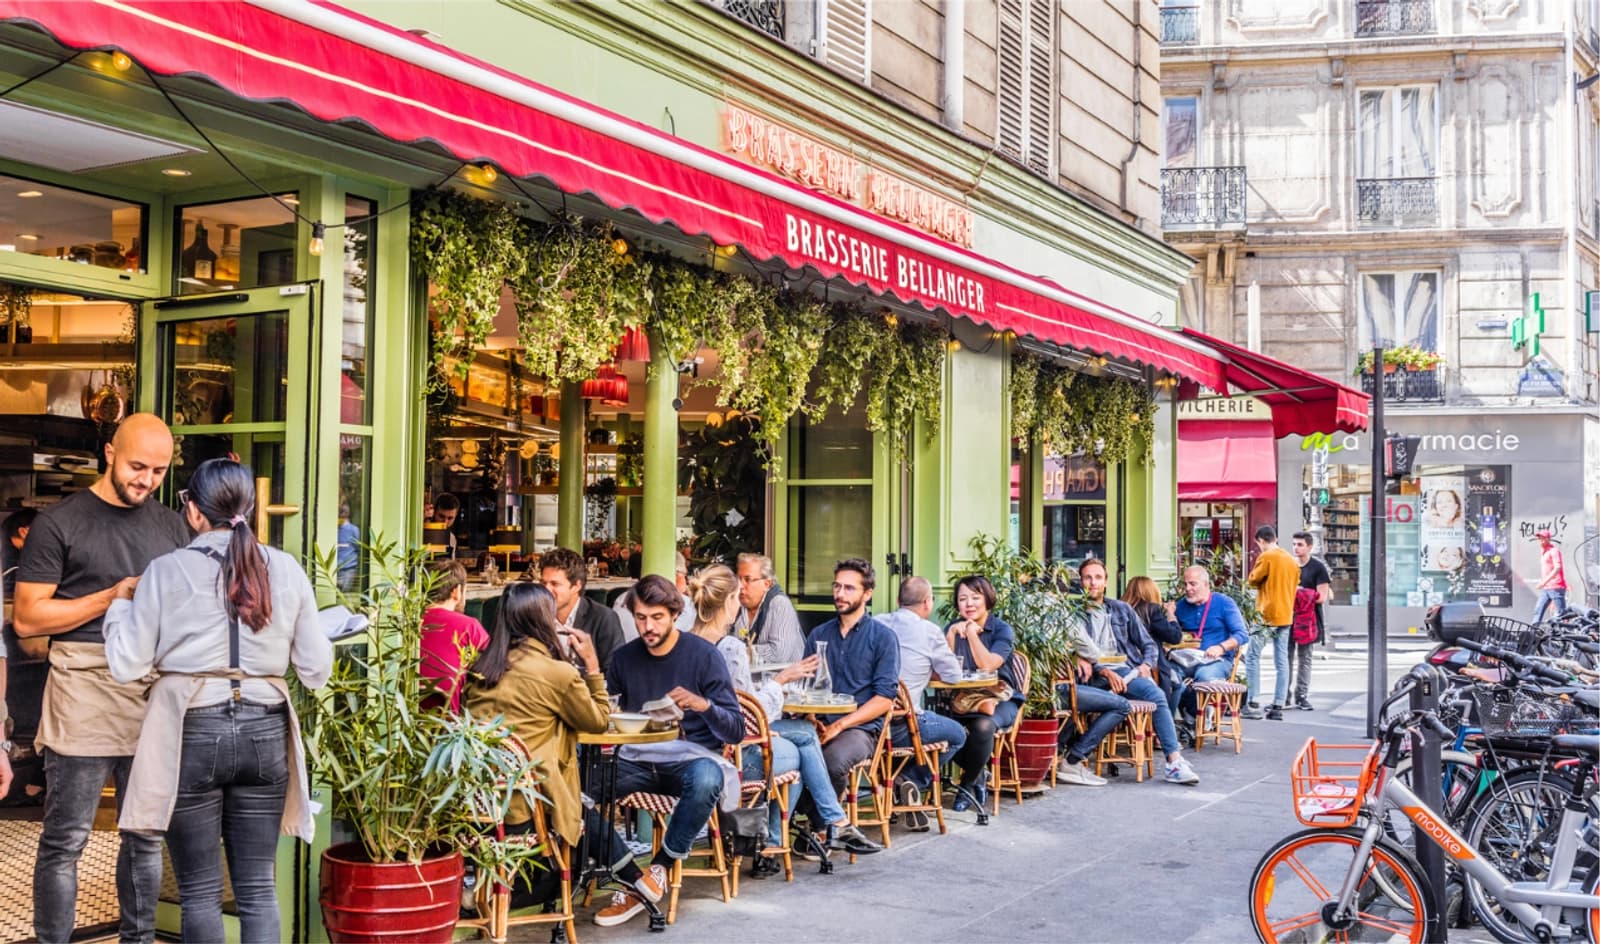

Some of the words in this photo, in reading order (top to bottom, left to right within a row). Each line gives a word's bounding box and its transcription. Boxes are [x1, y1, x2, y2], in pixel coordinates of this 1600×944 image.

[728, 109, 861, 201] BRASSERIE
[871, 168, 974, 248] BELLANGER
[785, 213, 888, 283] BRASSERIE
[897, 254, 985, 313] BELLANGER
[1371, 429, 1520, 451] rmacie
[1414, 811, 1461, 855] mobike
